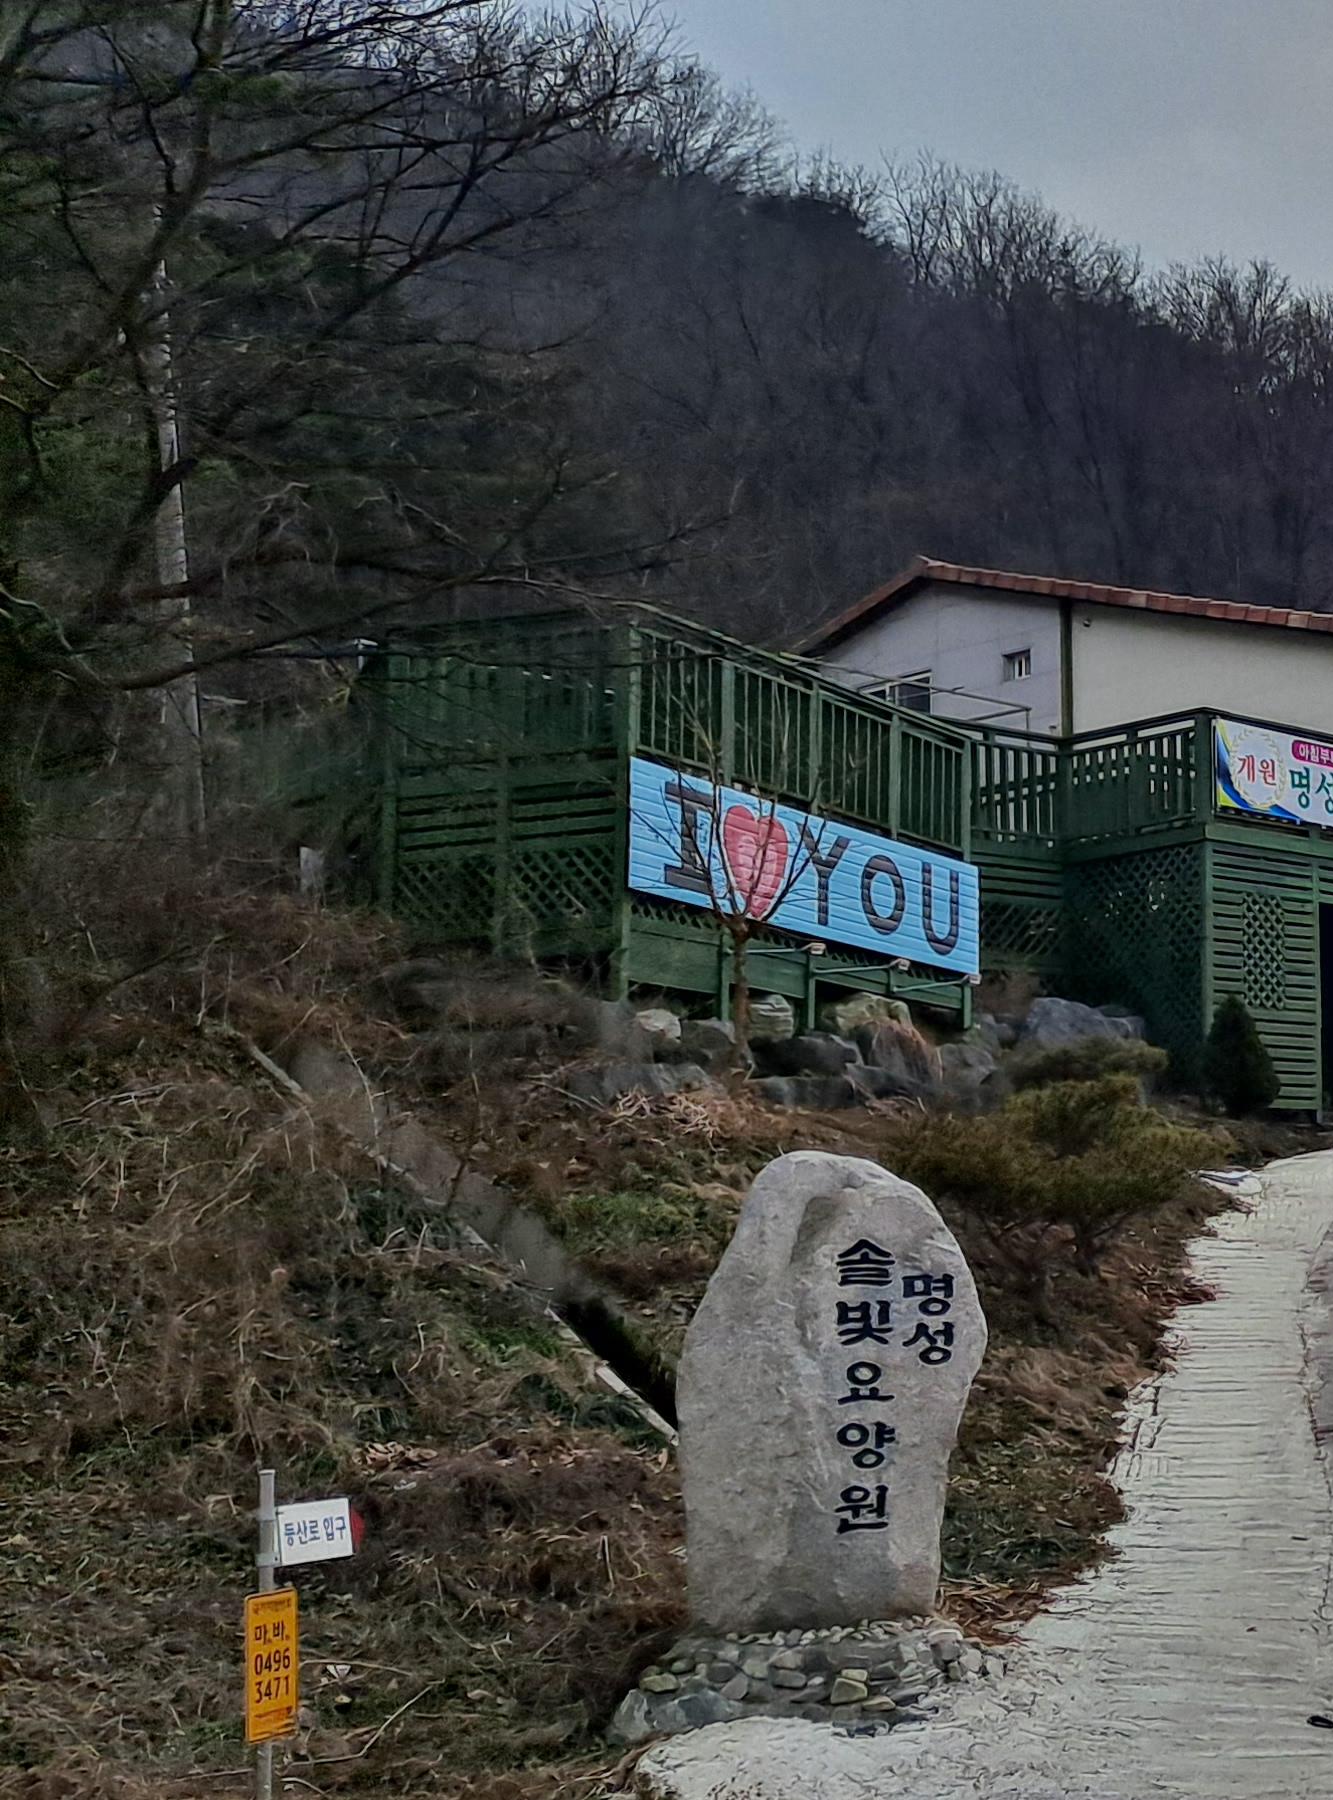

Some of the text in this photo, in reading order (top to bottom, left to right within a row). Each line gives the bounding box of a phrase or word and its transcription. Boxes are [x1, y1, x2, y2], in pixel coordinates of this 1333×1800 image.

[1237, 754, 1278, 787] 개원
[797, 820, 960, 956] YOU
[902, 1272, 955, 1366] 명성
[834, 1238, 897, 1535] 솔빛요양원
[283, 1515, 347, 1547] 등산로 입구
[254, 1648, 291, 1676] 0496
[254, 1675, 290, 1704] 3471
